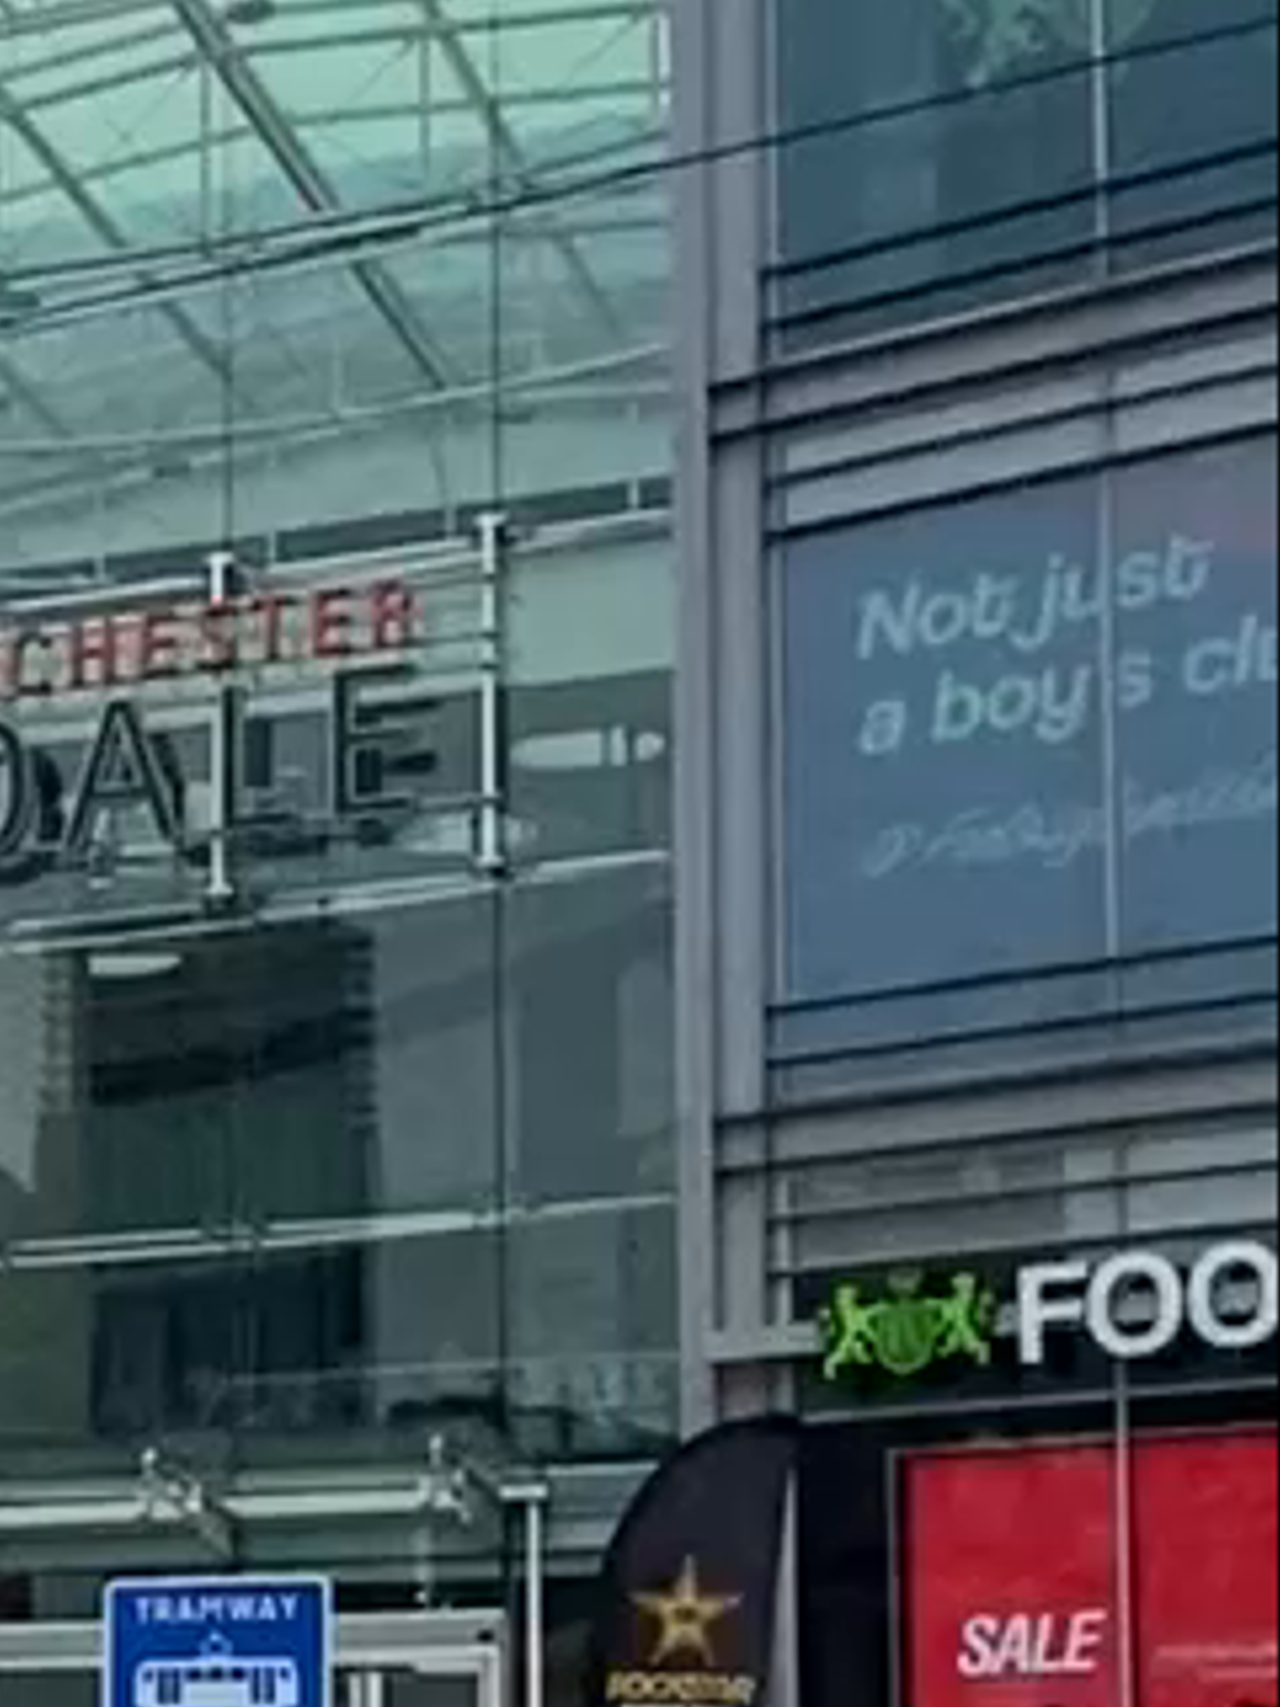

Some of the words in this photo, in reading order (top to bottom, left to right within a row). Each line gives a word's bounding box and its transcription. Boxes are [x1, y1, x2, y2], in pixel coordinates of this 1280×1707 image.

[857, 573, 1020, 659] Not
[1010, 534, 1215, 651] just
[859, 699, 906, 755] a
[933, 648, 1154, 743] boys
[1017, 1239, 1278, 1365] FOO
[135, 1594, 299, 1625] TRAMWAY
[956, 1608, 1108, 1677] SALE
